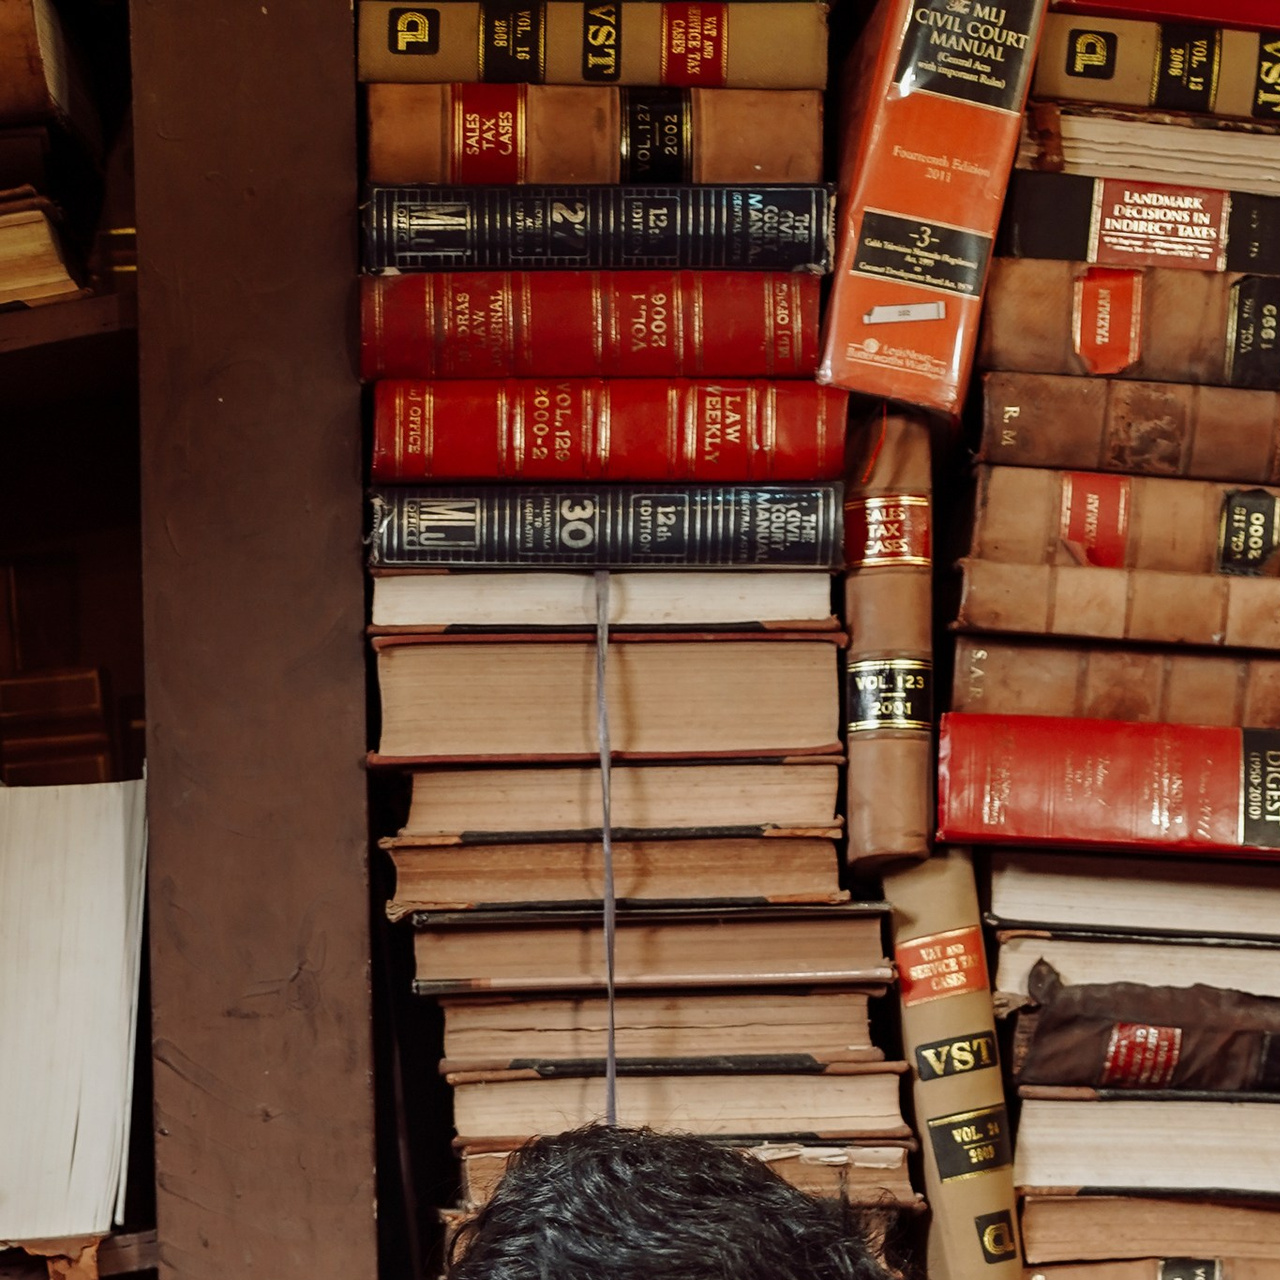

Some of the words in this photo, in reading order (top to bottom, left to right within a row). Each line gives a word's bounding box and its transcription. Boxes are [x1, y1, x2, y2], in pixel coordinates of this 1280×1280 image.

[915, 8, 962, 33] CIVIL
[967, 21, 1030, 50] COURT
[973, 3, 1006, 26] MLJ
[587, 3, 615, 74] VST
[671, 19, 685, 54] CASES
[930, 30, 1005, 62] MANUAL
[686, 53, 701, 74] TAX
[466, 113, 480, 155] SALES
[482, 118, 496, 150] TAX
[499, 111, 512, 155] CASES
[664, 114, 677, 156] 2002
[892, 144, 949, 168] Fourteenth
[952, 157, 991, 178] Edition
[1113, 203, 1190, 223] DECISIONS
[1192, 211, 1211, 225] IN
[1123, 190, 1204, 210] LANDMARK
[794, 213, 809, 243] THE
[1104, 217, 1174, 235] INDIRECT
[1176, 223, 1217, 239] TAXES
[650, 293, 667, 348] 2006
[1095, 289, 1111, 345] TAXMAN
[704, 384, 721, 464] WEEKLY
[725, 395, 741, 443] LAW
[407, 503, 417, 542] OFFICE
[419, 501, 476, 546] MLJ
[560, 499, 595, 549] 30
[641, 499, 652, 553] EDITION
[656, 505, 677, 542] 12th
[755, 492, 771, 562] MANUAL
[770, 504, 786, 551] COURT
[801, 513, 817, 543] THE
[865, 507, 906, 521] SALES
[867, 523, 901, 538] TAX
[864, 539, 908, 555] CASES
[1247, 512, 1265, 560] 2000
[870, 702, 912, 716] 2001
[1248, 751, 1262, 820] (1950-2010)
[921, 1037, 991, 1075] VST
